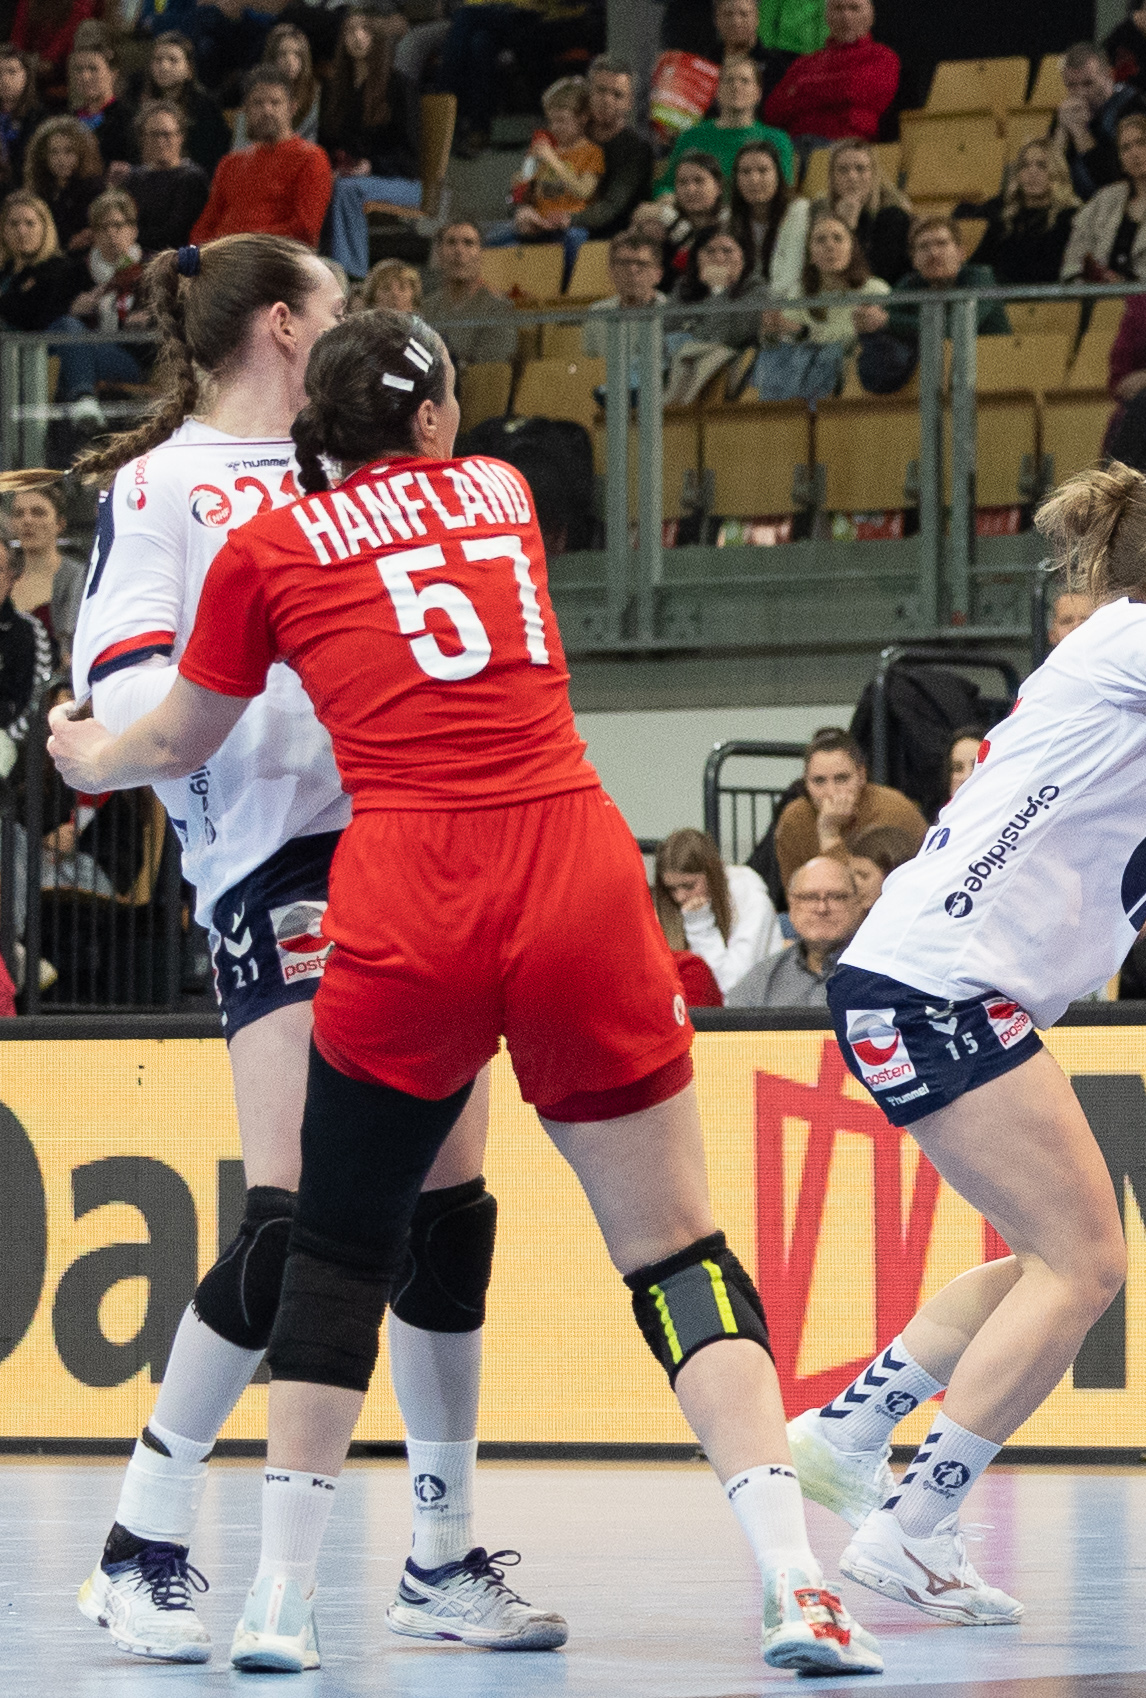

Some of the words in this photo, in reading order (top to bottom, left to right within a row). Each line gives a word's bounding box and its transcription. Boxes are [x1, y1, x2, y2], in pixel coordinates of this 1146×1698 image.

[291, 459, 531, 566] HANFLAND
[376, 534, 549, 682] 57
[231, 957, 260, 989] 21
[284, 956, 327, 980] post
[945, 1031, 979, 1061] 15
